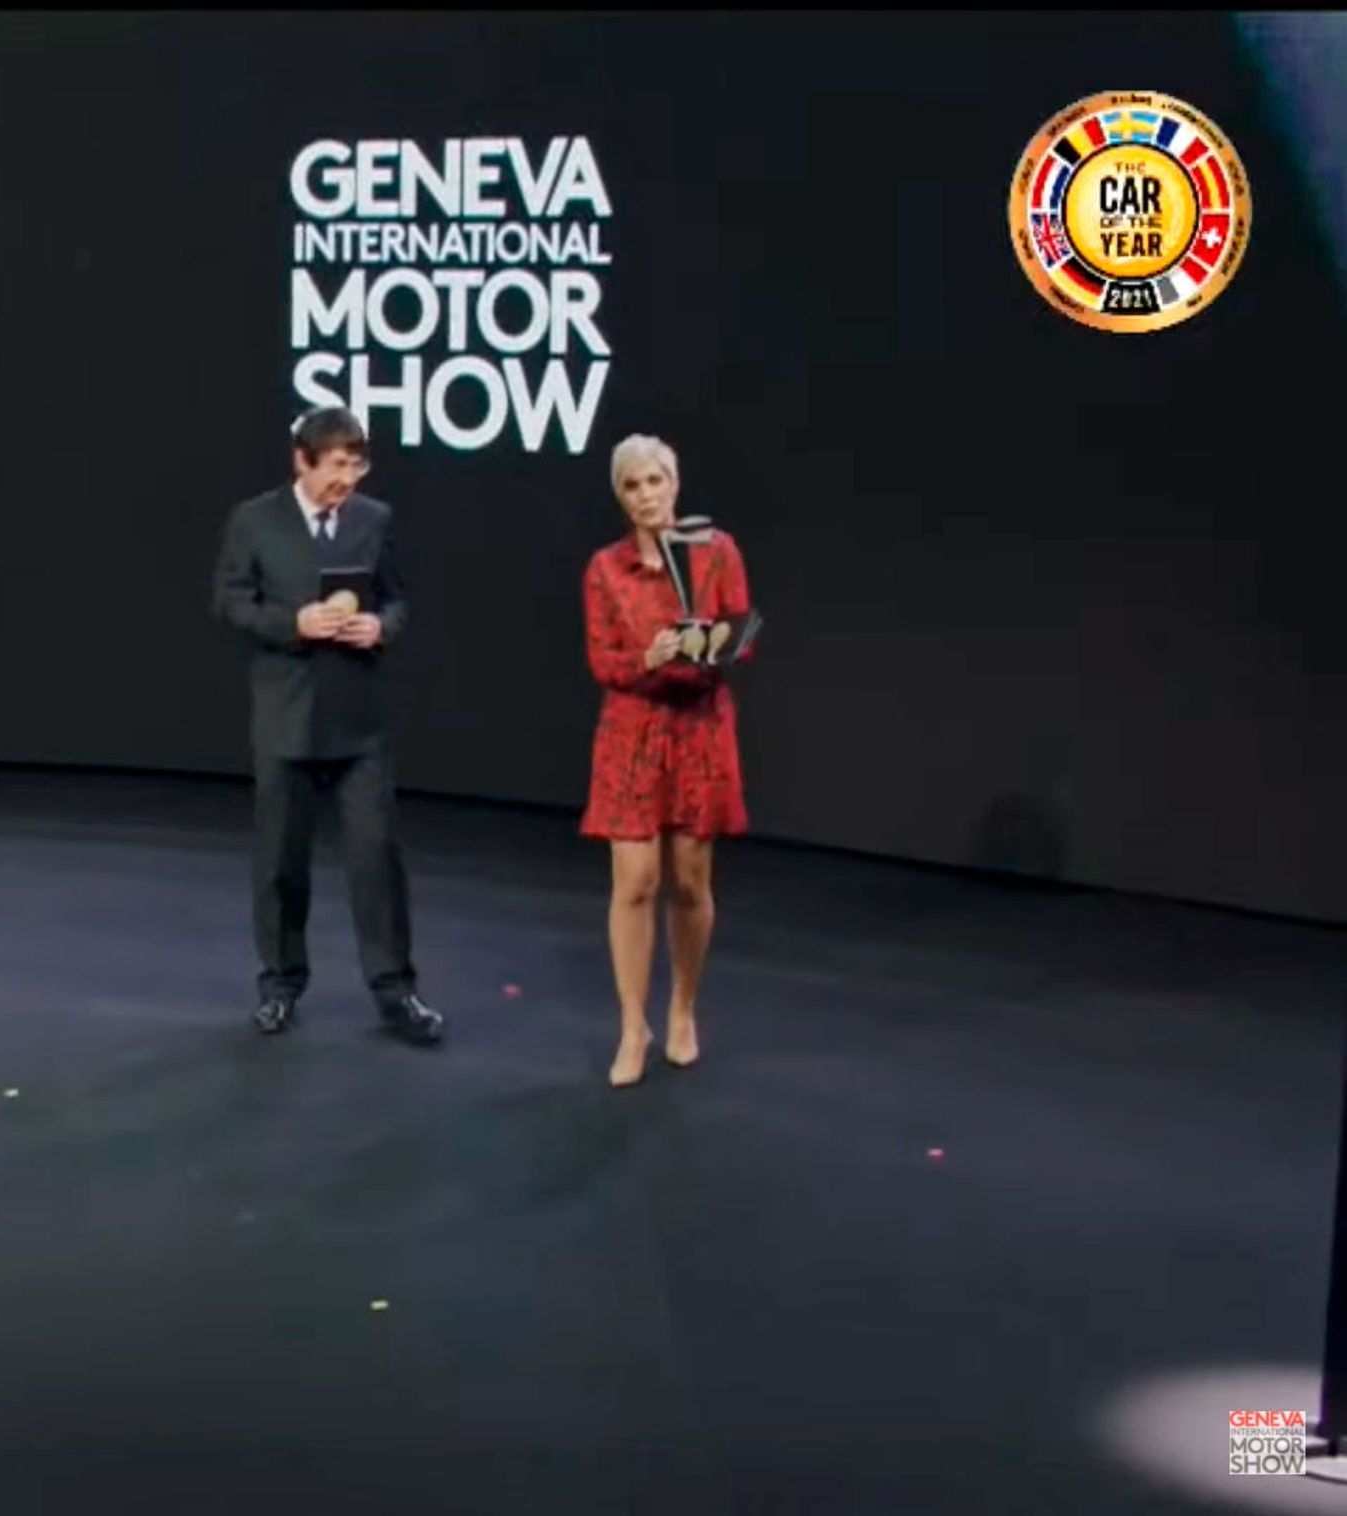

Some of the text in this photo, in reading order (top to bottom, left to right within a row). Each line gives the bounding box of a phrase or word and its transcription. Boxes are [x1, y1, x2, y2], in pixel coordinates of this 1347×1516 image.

[290, 136, 613, 218] GENEVA
[293, 222, 613, 264] INTERNATIONAL
[291, 267, 612, 356] MOTOR
[291, 352, 611, 454] SHOW
